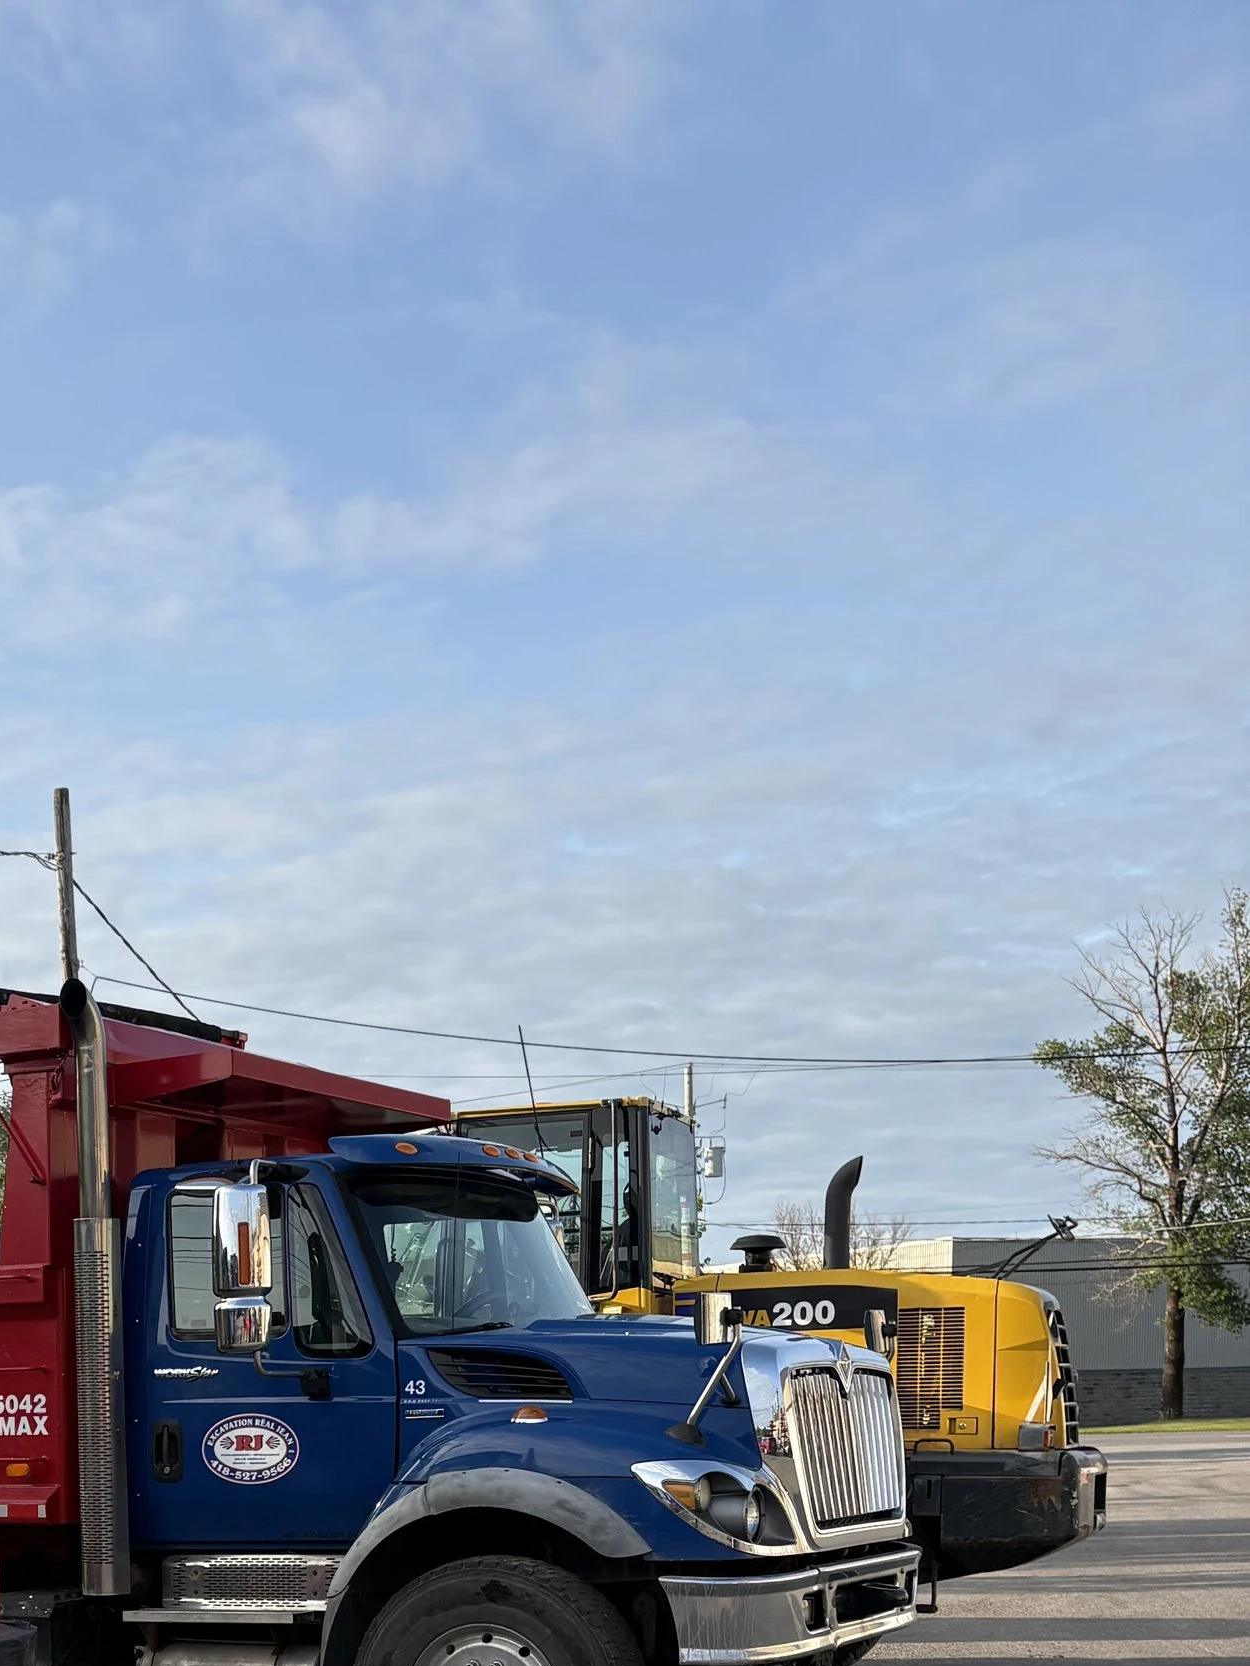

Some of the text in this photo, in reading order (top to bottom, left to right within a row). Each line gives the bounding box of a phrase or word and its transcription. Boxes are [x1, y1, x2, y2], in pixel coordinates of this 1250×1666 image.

[404, 1379, 426, 1395] 43
[207, 1417, 295, 1447] EXCAVATION RÉAL JEAN
[234, 1434, 265, 1452] RJ
[210, 1457, 292, 1481] 418-527-9566
